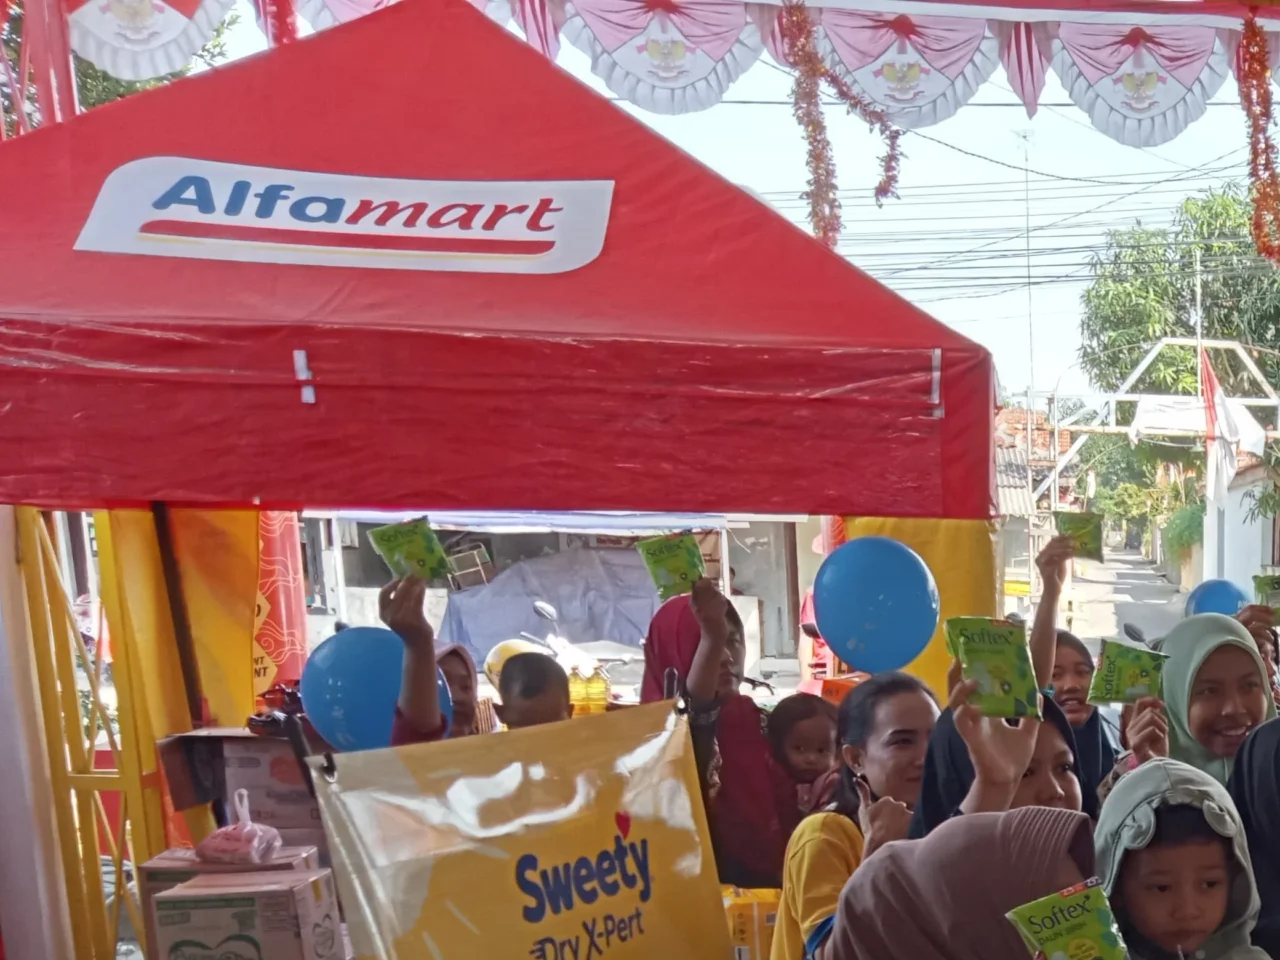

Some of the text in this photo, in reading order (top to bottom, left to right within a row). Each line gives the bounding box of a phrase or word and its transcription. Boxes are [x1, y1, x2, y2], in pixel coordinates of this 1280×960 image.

[152, 175, 564, 232] Alfamart
[959, 628, 1013, 646] Softex
[1103, 656, 1116, 699] Softex
[515, 834, 652, 924] Sweety
[1028, 895, 1092, 934] Softex
